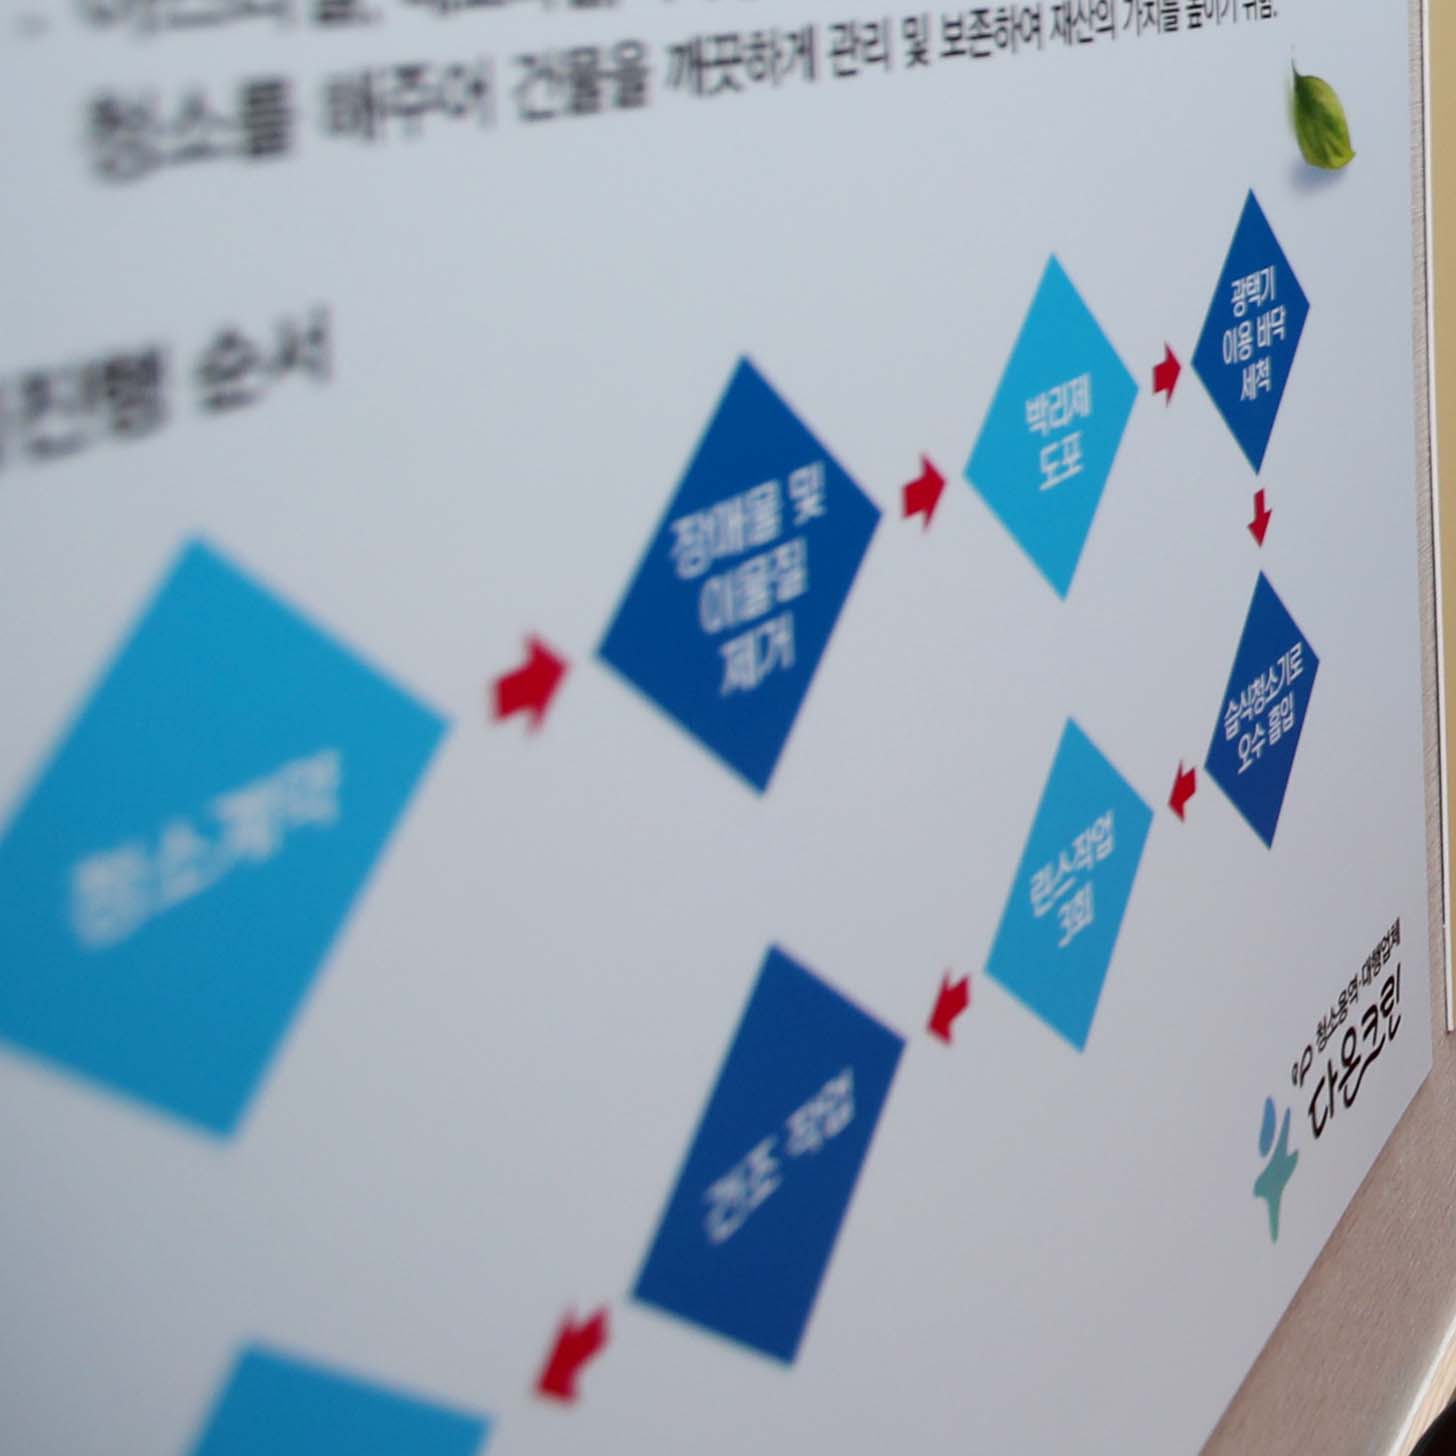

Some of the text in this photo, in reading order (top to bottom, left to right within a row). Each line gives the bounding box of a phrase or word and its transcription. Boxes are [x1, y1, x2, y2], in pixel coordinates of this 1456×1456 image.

[511, 38, 651, 124] 건물을
[664, 26, 818, 99] 깨끗하게
[826, 18, 891, 80] 관리
[904, 13, 932, 70] 및
[939, 1, 1045, 60] 보존하여
[1221, 304, 1287, 366] 이용 바닥
[1230, 264, 1277, 319] 광택기
[0, 341, 170, 474] 진행
[1024, 371, 1092, 437] 박리제
[1240, 355, 1273, 402] 세척
[788, 457, 828, 527] 및
[1038, 429, 1085, 493] 도포
[698, 534, 809, 636] 이물질
[717, 607, 797, 699] 제거
[1223, 641, 1304, 742] 습식청소기로
[1236, 690, 1295, 776] 오수 흡입
[1028, 808, 1116, 920] 린스작업
[1308, 961, 1401, 1140] 다온크린
[701, 1134, 783, 1247] 건조
